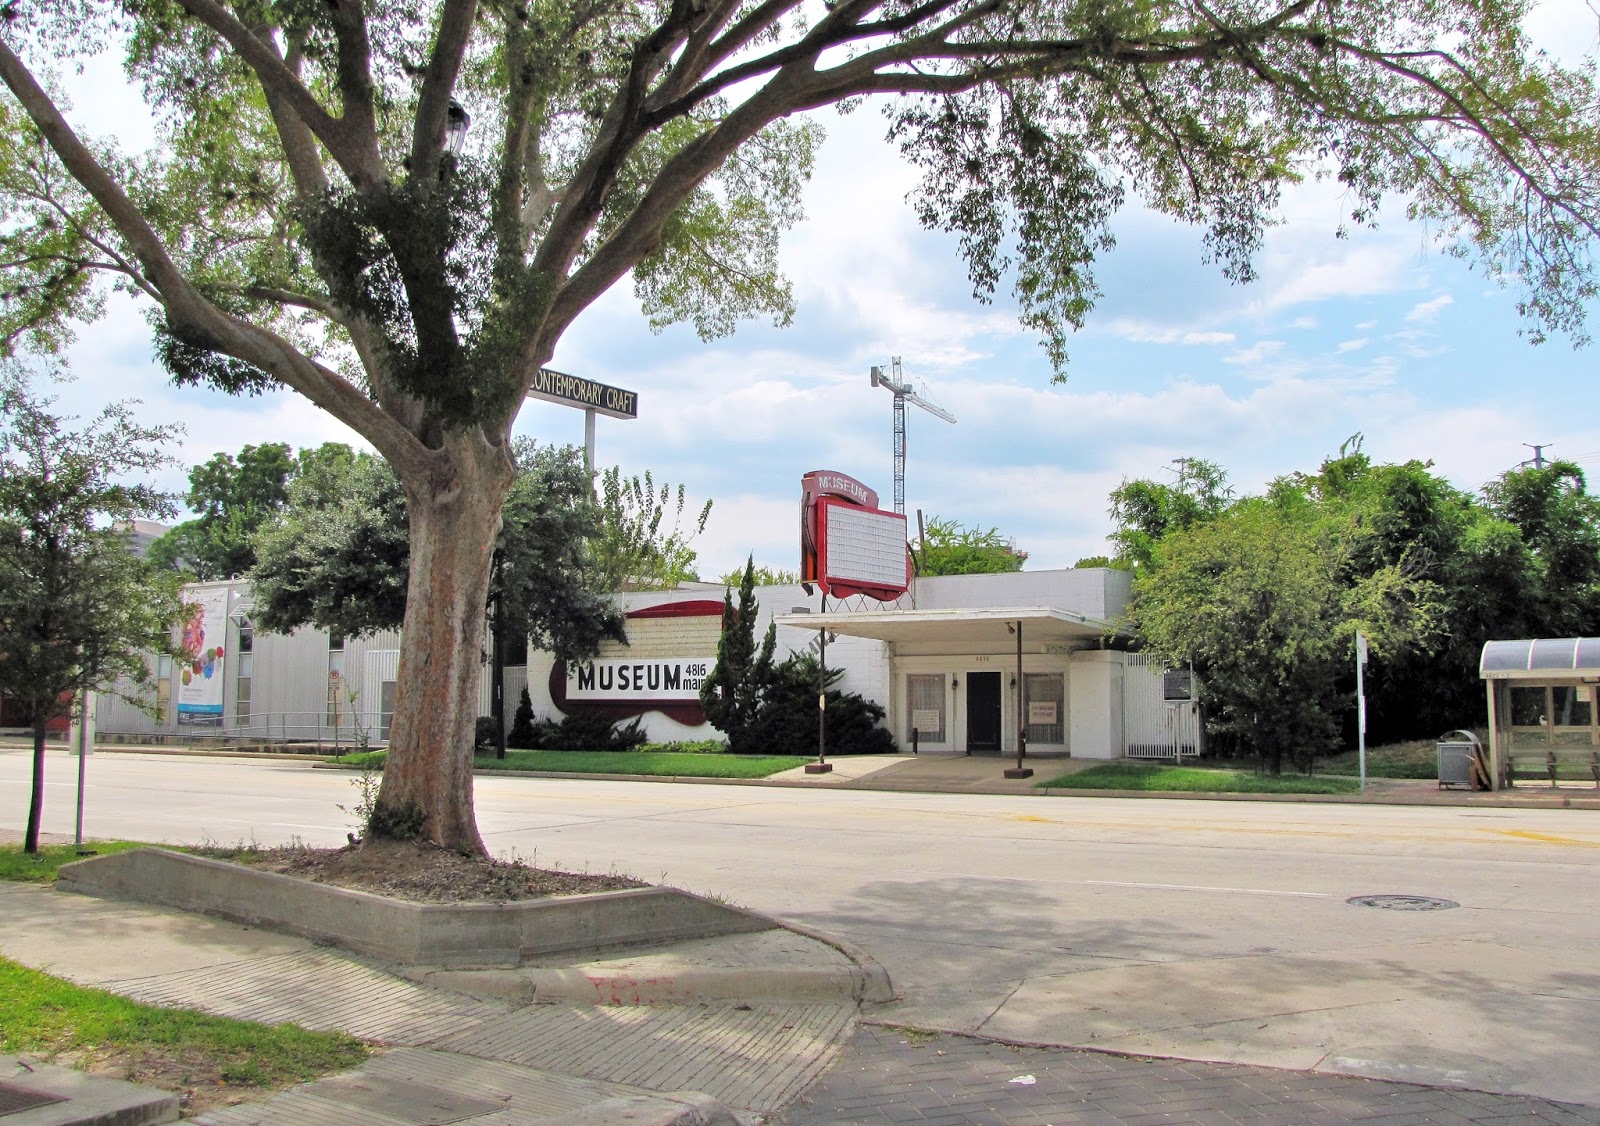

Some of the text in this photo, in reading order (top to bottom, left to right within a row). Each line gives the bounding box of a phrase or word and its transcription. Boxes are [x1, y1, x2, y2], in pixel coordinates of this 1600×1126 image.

[531, 370, 634, 413] ONTEMPORARY CRAFT
[818, 476, 868, 502] MUSEUM
[578, 664, 681, 690] MUSEUM
[685, 664, 706, 676] 4816
